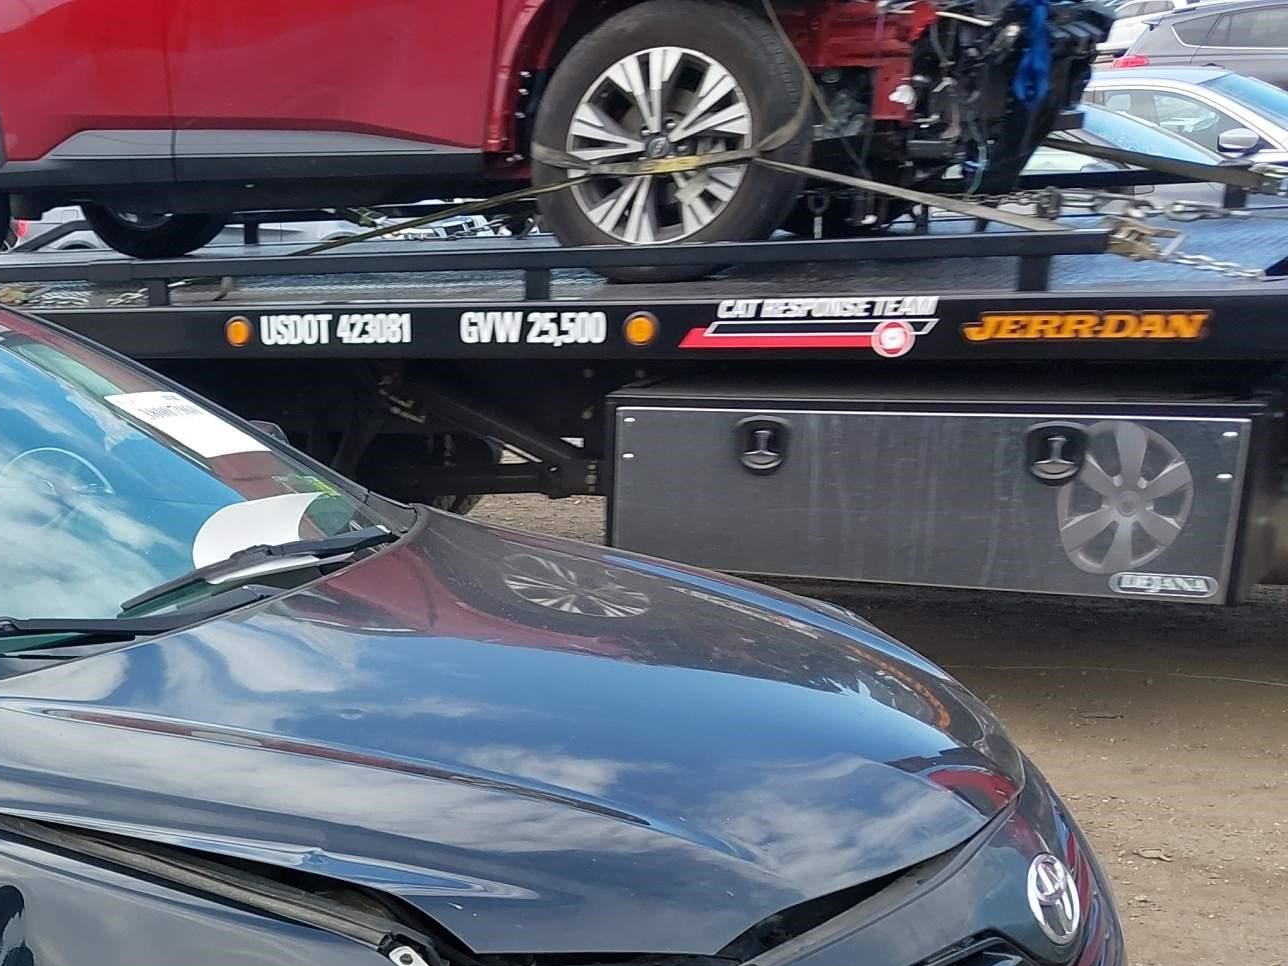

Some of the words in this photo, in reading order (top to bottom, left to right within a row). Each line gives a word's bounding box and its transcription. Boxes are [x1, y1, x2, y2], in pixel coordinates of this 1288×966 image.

[716, 299, 764, 319] CAT
[759, 297, 875, 318] RESPONSE
[872, 295, 941, 316] TEAM
[259, 313, 333, 346] USDOT
[336, 313, 412, 344] 423081
[460, 311, 524, 344] GVW
[526, 311, 607, 347] 25,500
[962, 311, 1210, 342] JERR-DAN
